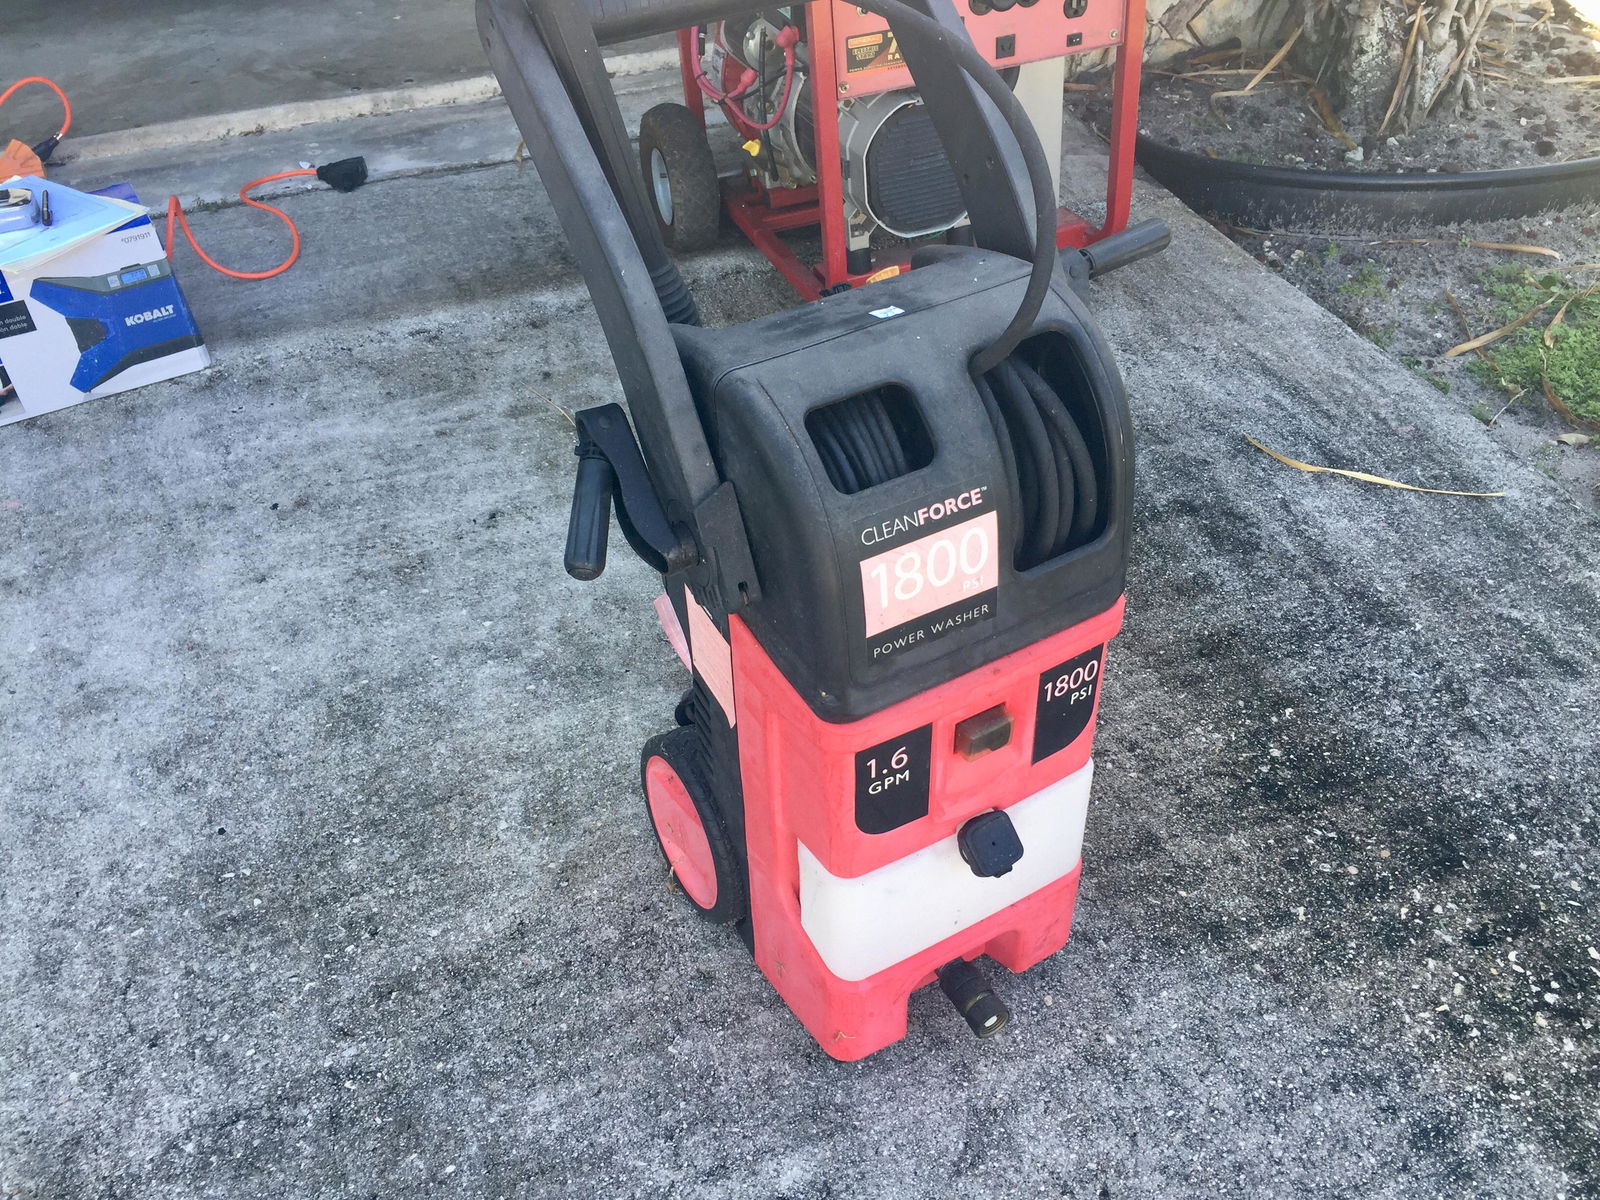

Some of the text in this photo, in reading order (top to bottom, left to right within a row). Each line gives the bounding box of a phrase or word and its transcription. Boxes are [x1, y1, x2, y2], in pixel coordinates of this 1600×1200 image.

[5, 315, 26, 324] double
[124, 304, 174, 326] KOBALT
[871, 526, 988, 609] 1800
[963, 576, 984, 592] PSI
[873, 604, 989, 658] POWER WASHER
[1043, 659, 1099, 703] 1800
[1070, 684, 1092, 705] PSI
[866, 746, 909, 779] 1.6
[868, 769, 910, 795] GPM
